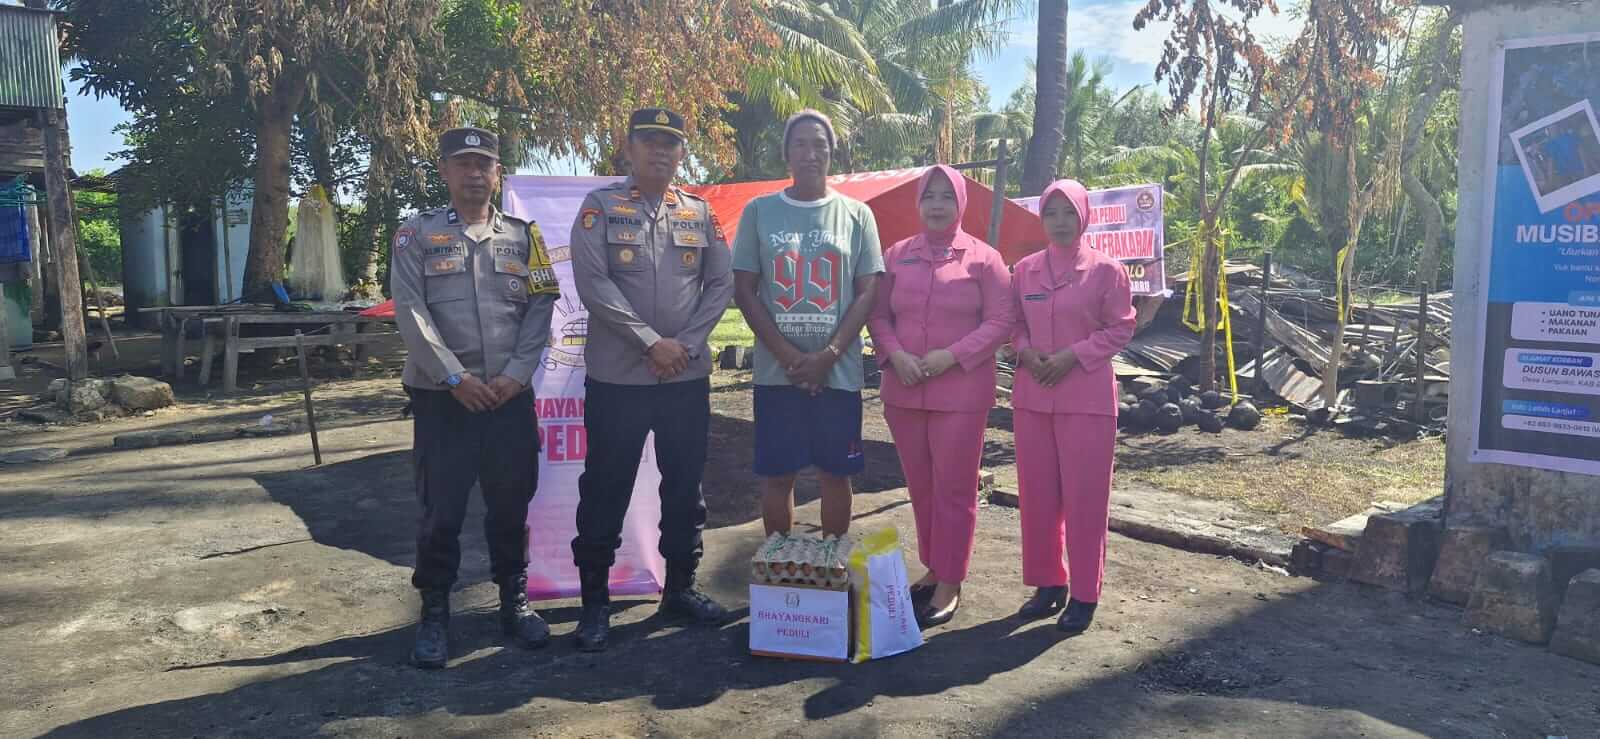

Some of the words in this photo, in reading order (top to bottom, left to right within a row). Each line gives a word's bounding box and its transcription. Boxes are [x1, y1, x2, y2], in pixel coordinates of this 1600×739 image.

[1100, 205, 1126, 223] PEDULI
[672, 220, 704, 231] POLRI
[769, 231, 804, 247] New
[1516, 224, 1600, 243] MUSIB
[773, 250, 841, 313] 99
[1548, 319, 1596, 328] MAKANAN
[1548, 327, 1588, 336] PAKAIAN
[1522, 365, 1560, 375] DUSUN
[757, 609, 831, 626] BHAYANGKARI
[776, 626, 811, 640] PEDULI
